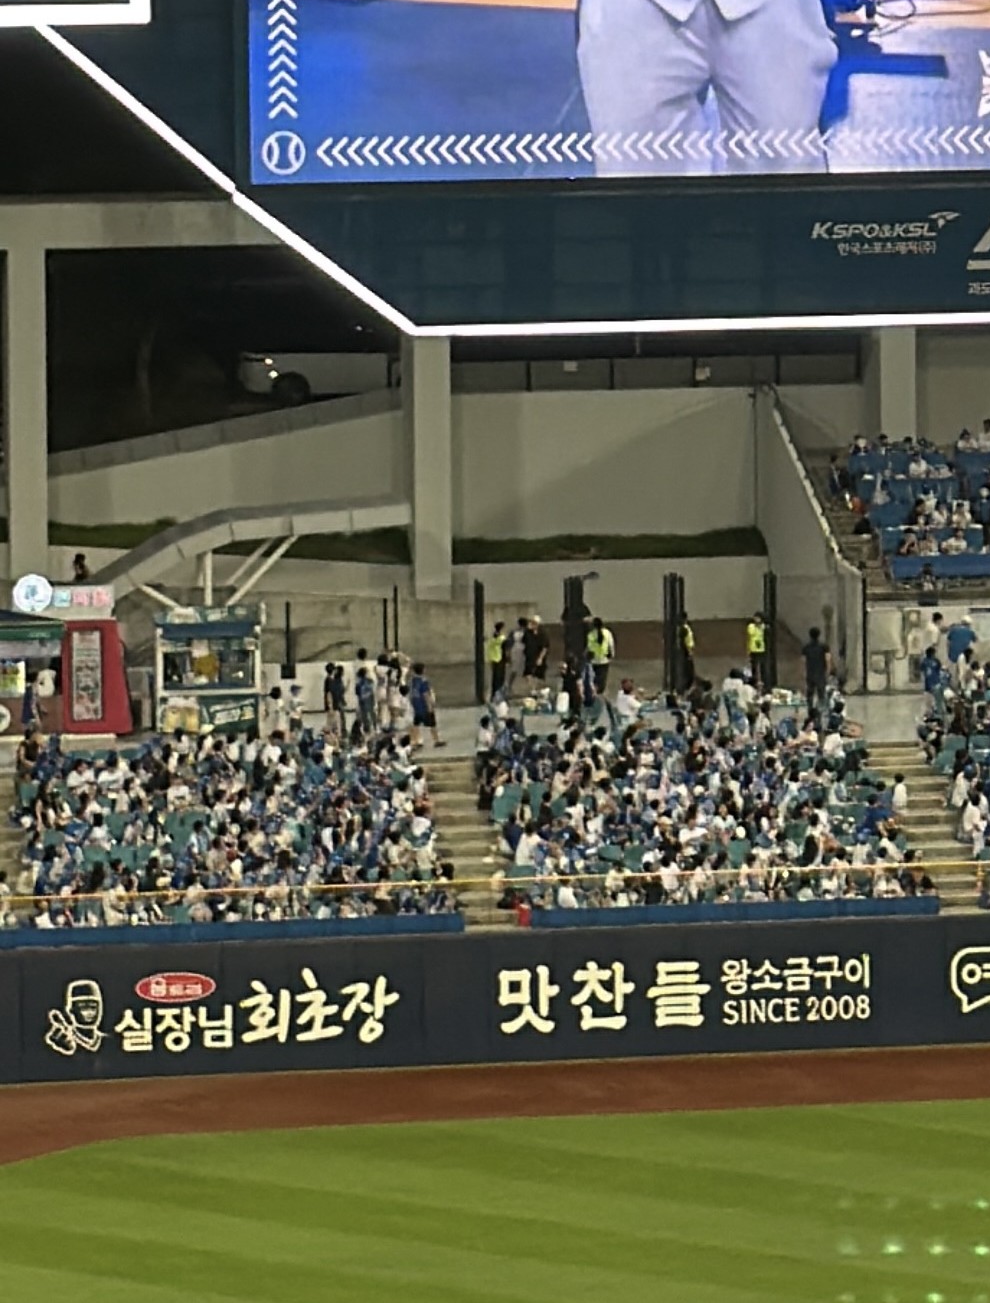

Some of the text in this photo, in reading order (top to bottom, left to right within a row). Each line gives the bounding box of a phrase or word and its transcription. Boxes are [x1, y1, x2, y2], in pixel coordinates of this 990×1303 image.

[720, 953, 870, 995] 왕소금구이
[114, 967, 400, 1053] 실장님 회초장
[722, 994, 871, 1026] SINCE 2008
